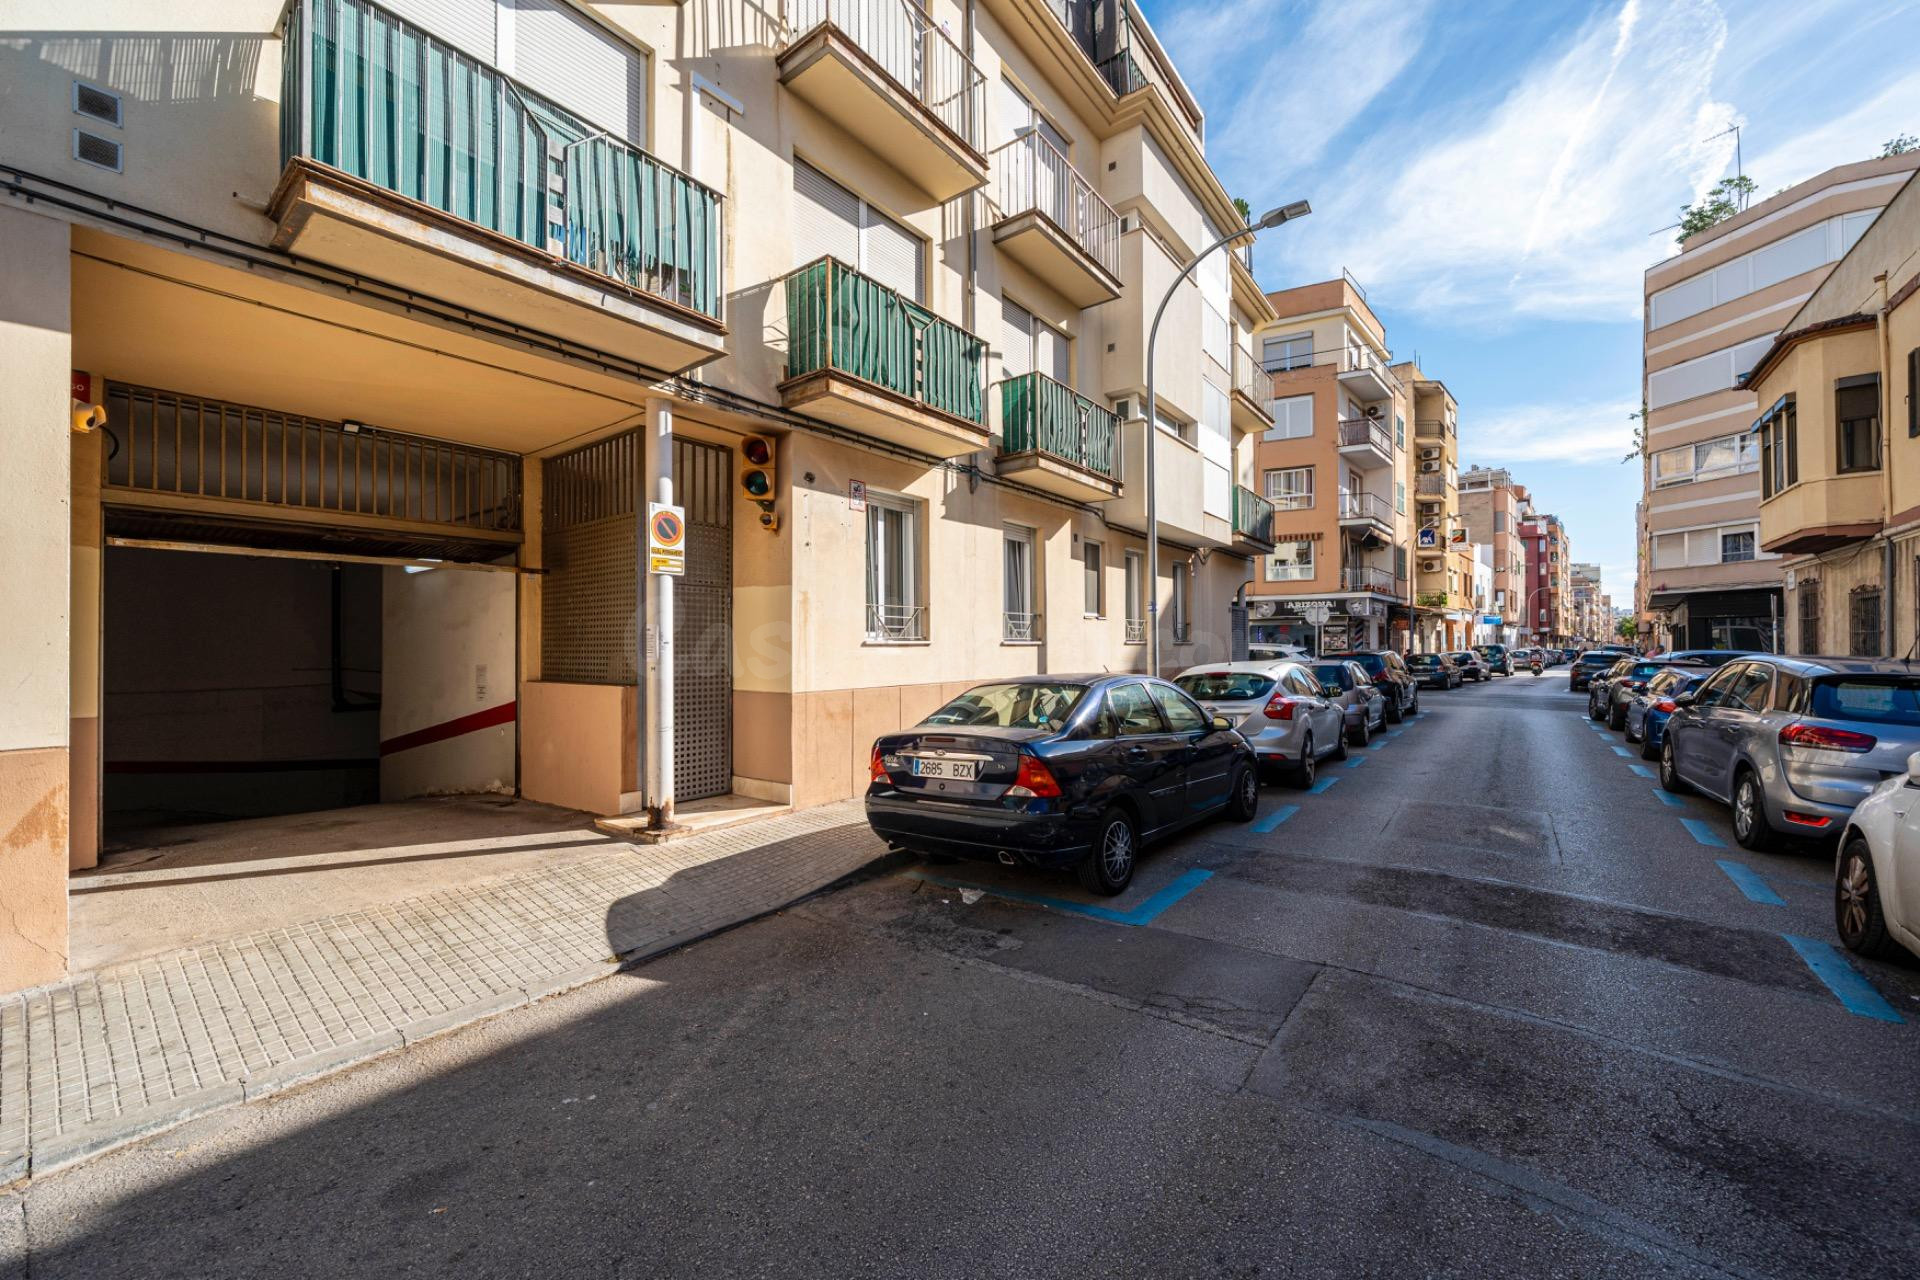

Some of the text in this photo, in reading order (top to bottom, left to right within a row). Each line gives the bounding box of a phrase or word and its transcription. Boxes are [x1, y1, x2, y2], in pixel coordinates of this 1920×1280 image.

[1287, 600, 1334, 609] ARIZONA
[920, 762, 972, 778] 2685 BZX
